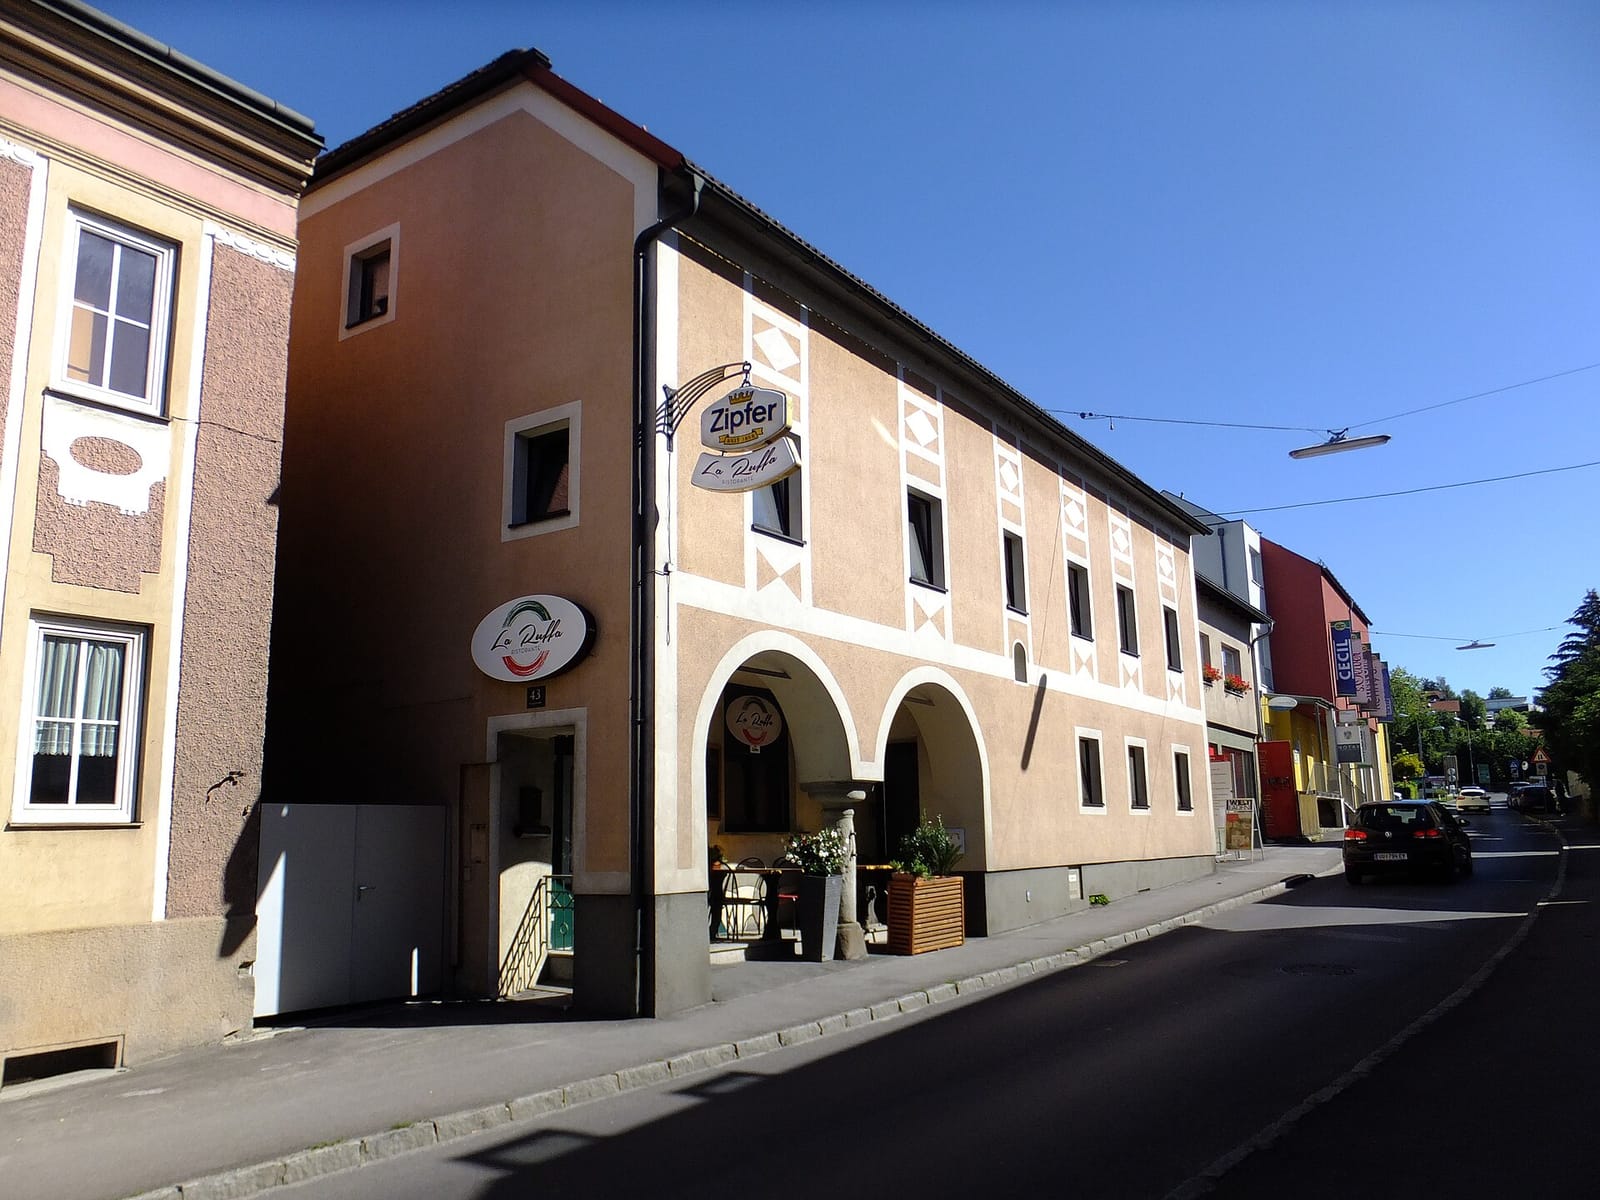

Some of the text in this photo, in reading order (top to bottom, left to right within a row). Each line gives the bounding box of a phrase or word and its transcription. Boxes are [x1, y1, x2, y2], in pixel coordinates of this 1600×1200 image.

[710, 402, 777, 434] Zipfer
[702, 446, 777, 479] La Ruffa
[490, 619, 562, 651] La Ruffa
[1336, 639, 1351, 680] CECIL
[529, 688, 541, 700] 43
